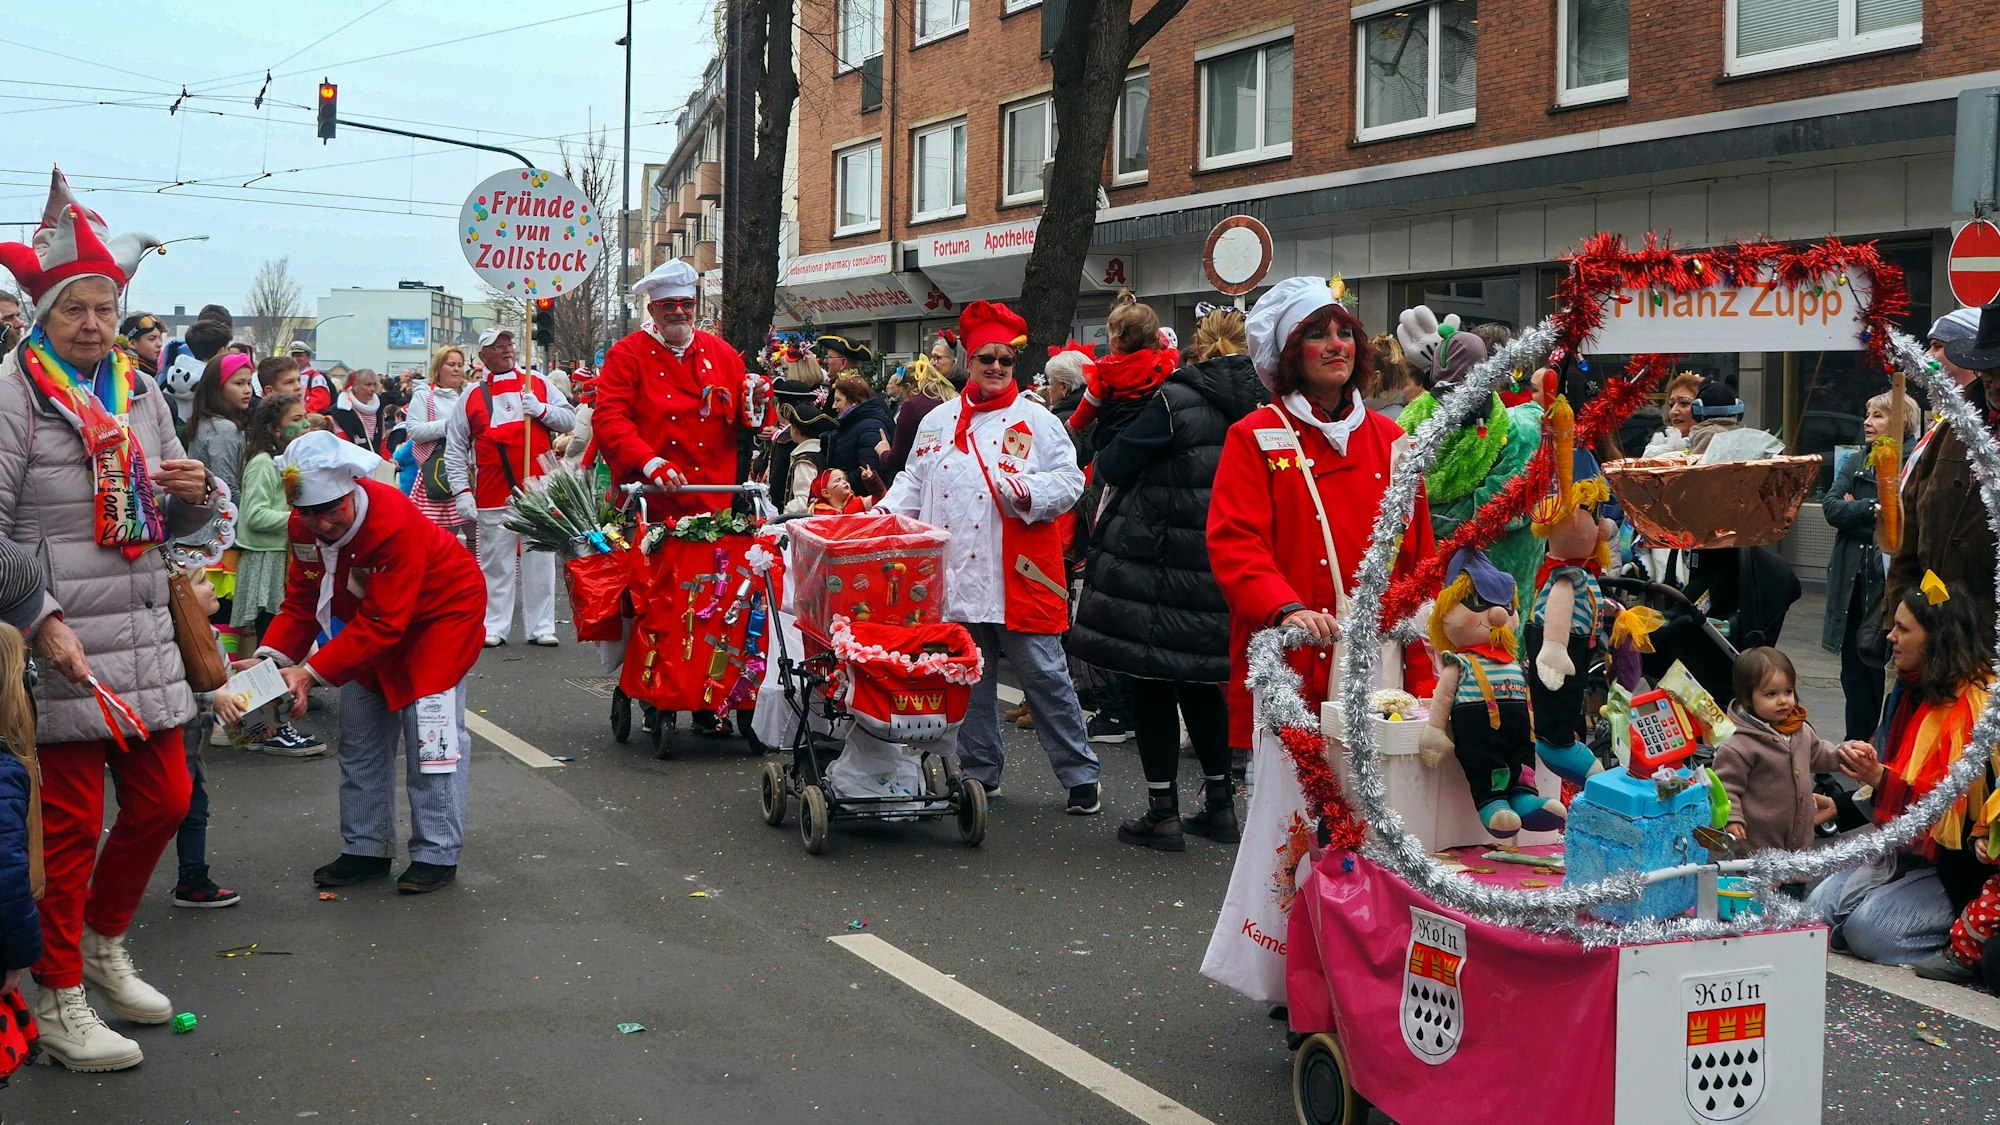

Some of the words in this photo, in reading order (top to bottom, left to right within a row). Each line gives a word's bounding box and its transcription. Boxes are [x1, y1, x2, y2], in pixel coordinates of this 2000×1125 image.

[491, 190, 575, 219] Fründe
[516, 224, 550, 241] vun
[933, 239, 971, 257] Fortuna
[984, 227, 1035, 254] Apotheke
[475, 243, 588, 272] Zollstock
[824, 258, 852, 274] pharmacy
[852, 253, 888, 268] consultancy
[799, 294, 853, 313] Fortuna
[846, 286, 914, 312] Apotheke
[1748, 282, 1843, 326] Zupp
[103, 494, 119, 522] 200
[122, 488, 137, 521] Alaaf
[1241, 918, 1287, 956] Kame
[1418, 917, 1458, 950] Köln
[1694, 978, 1761, 1006] Köln
